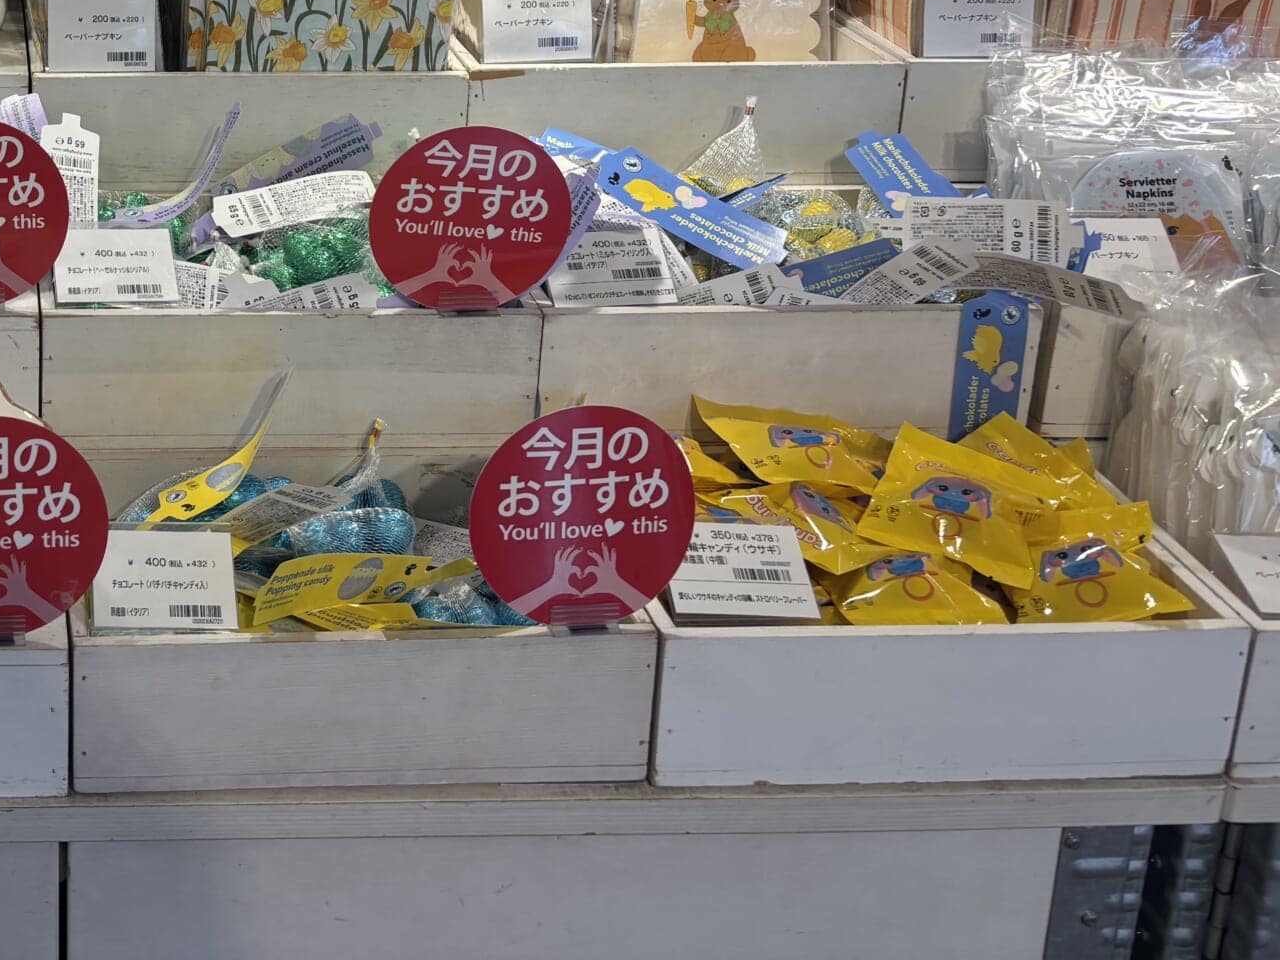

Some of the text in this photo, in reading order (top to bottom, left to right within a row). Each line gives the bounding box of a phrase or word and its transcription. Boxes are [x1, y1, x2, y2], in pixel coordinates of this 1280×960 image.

[521, 0, 537, 8] 200
[494, 19, 553, 27] ペーパーナプキン
[74, 140, 85, 149] 65
[295, 155, 322, 175] cream
[424, 139, 537, 182] 今月の
[1119, 177, 1177, 187] Servietter
[396, 178, 549, 222] おすすめ
[1126, 187, 1174, 200] Napkins
[12, 214, 45, 230] this
[395, 217, 543, 243] You'll love this
[689, 212, 745, 243] chocolates
[95, 249, 112, 257] 400
[521, 426, 649, 471] 今月の
[498, 468, 669, 517] おすすめ
[498, 516, 668, 540] You'll love this
[710, 530, 731, 540] 350
[41, 530, 80, 548] this
[145, 558, 166, 567] 400
[303, 575, 333, 587] candy
